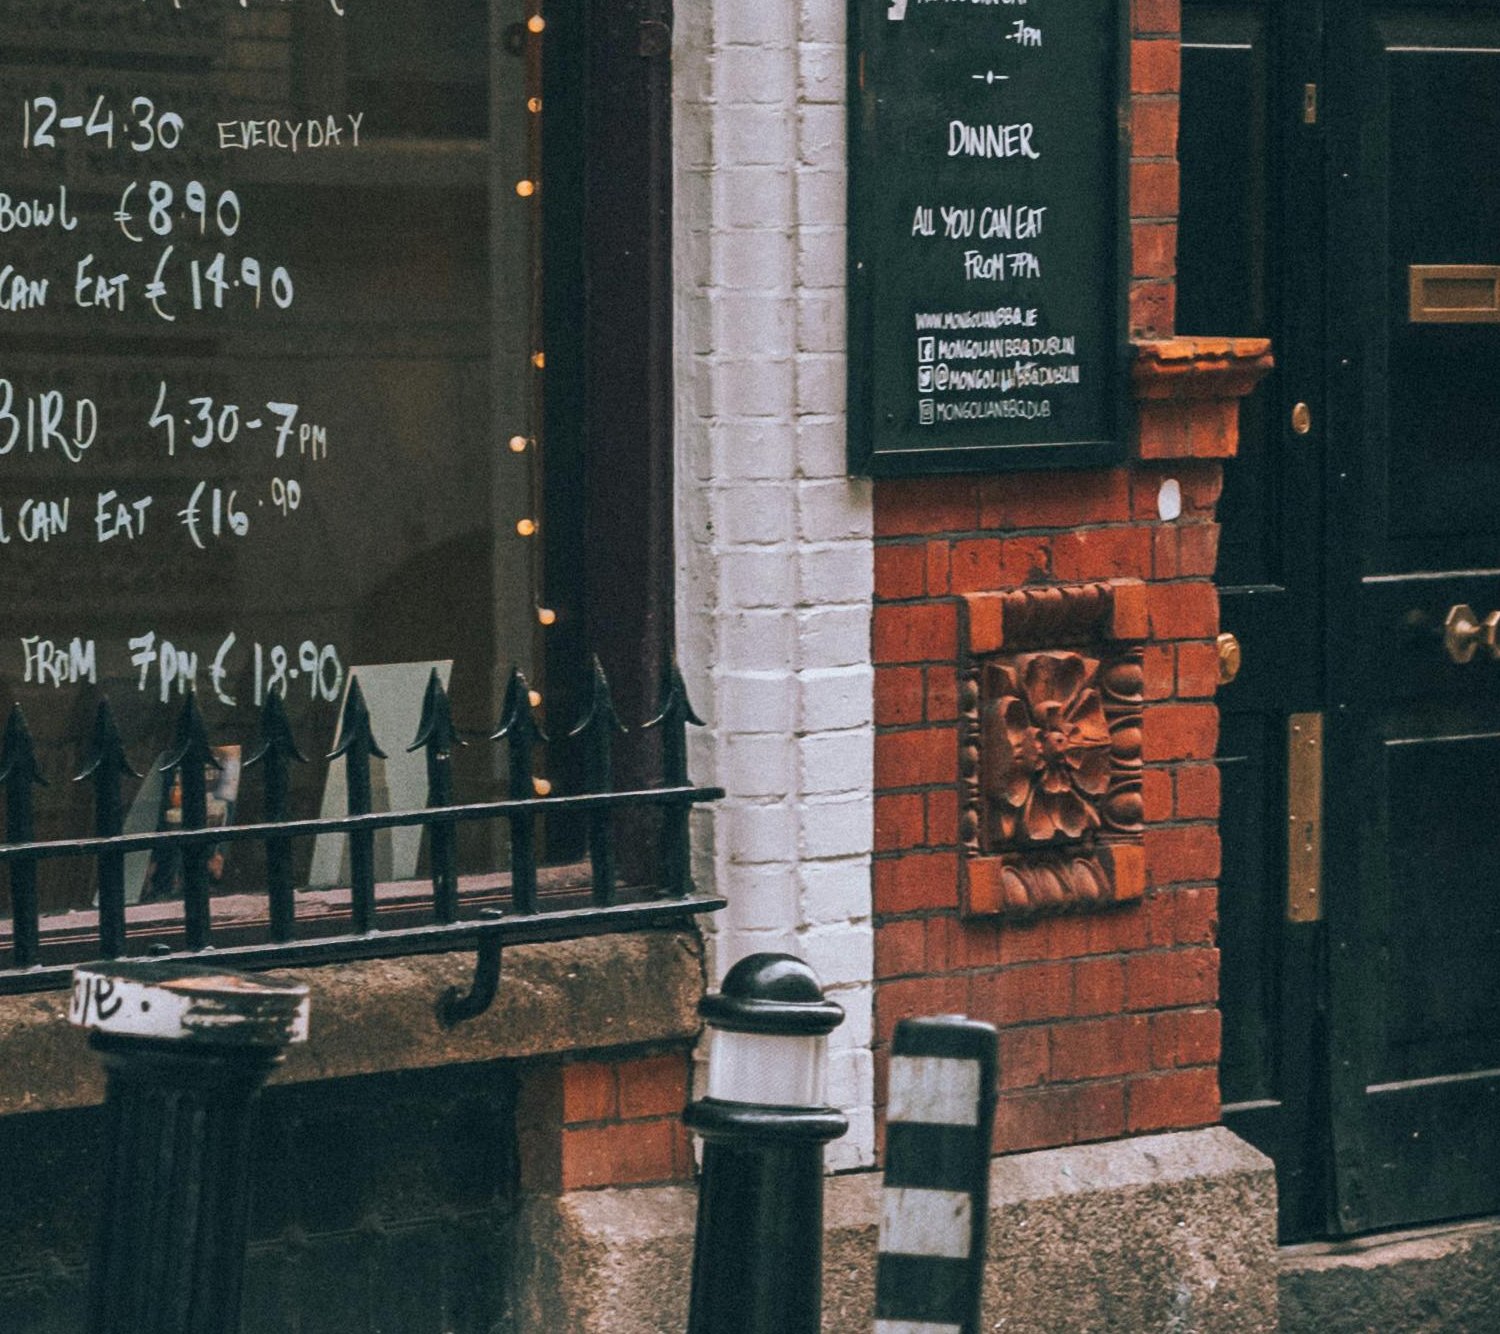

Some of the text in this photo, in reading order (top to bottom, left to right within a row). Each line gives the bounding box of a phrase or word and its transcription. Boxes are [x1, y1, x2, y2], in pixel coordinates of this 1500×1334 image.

[217, 112, 365, 153] EVERYDAY
[947, 120, 1041, 160] DINNER
[912, 205, 1048, 240] ALL YOU CAN EAT
[964, 250, 1041, 282] FROM 7PM
[20, 634, 98, 690] FROM
[128, 629, 199, 704] 7PM
